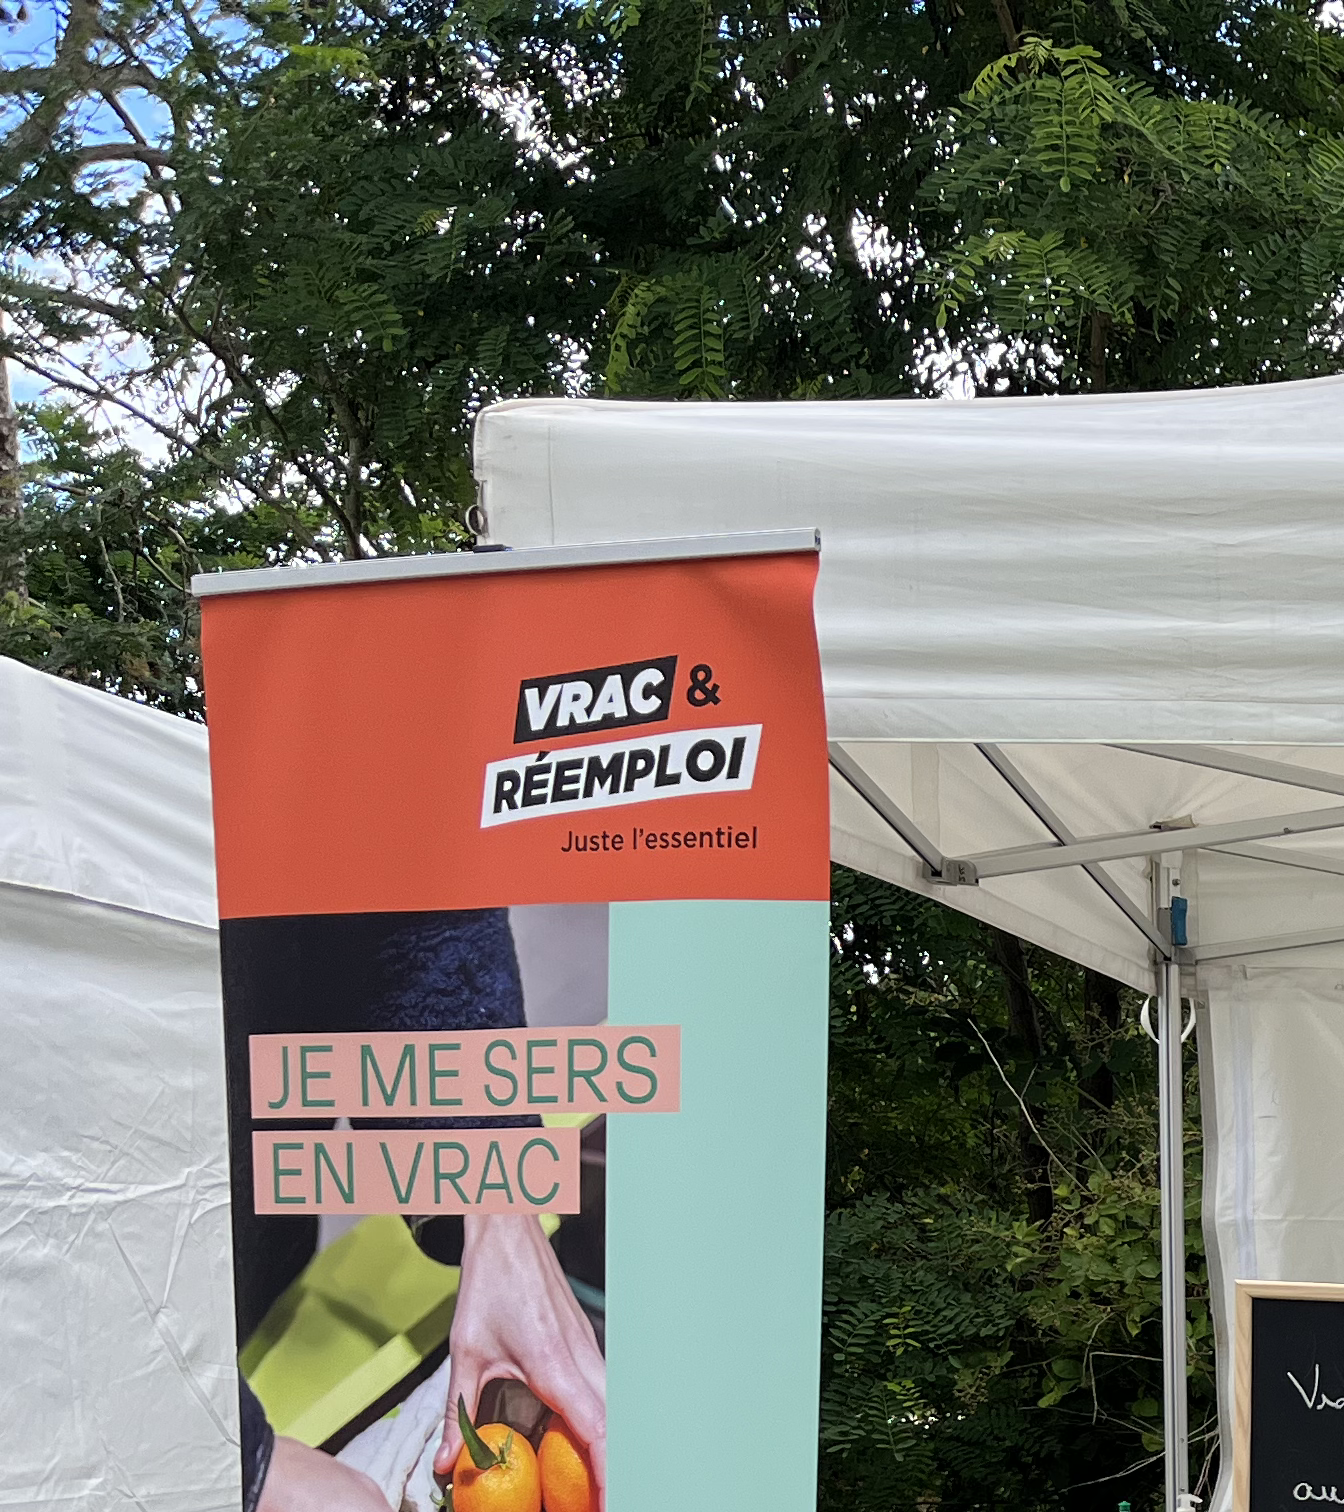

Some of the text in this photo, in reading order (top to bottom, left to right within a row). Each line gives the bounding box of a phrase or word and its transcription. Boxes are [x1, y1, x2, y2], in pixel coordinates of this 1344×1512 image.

[524, 663, 722, 732] VRAC &
[492, 736, 747, 815] RÉEMPLOI
[561, 828, 624, 853] Juste
[268, 1034, 659, 1111] JE ME SERS
[272, 1136, 562, 1205] EN VRAC
